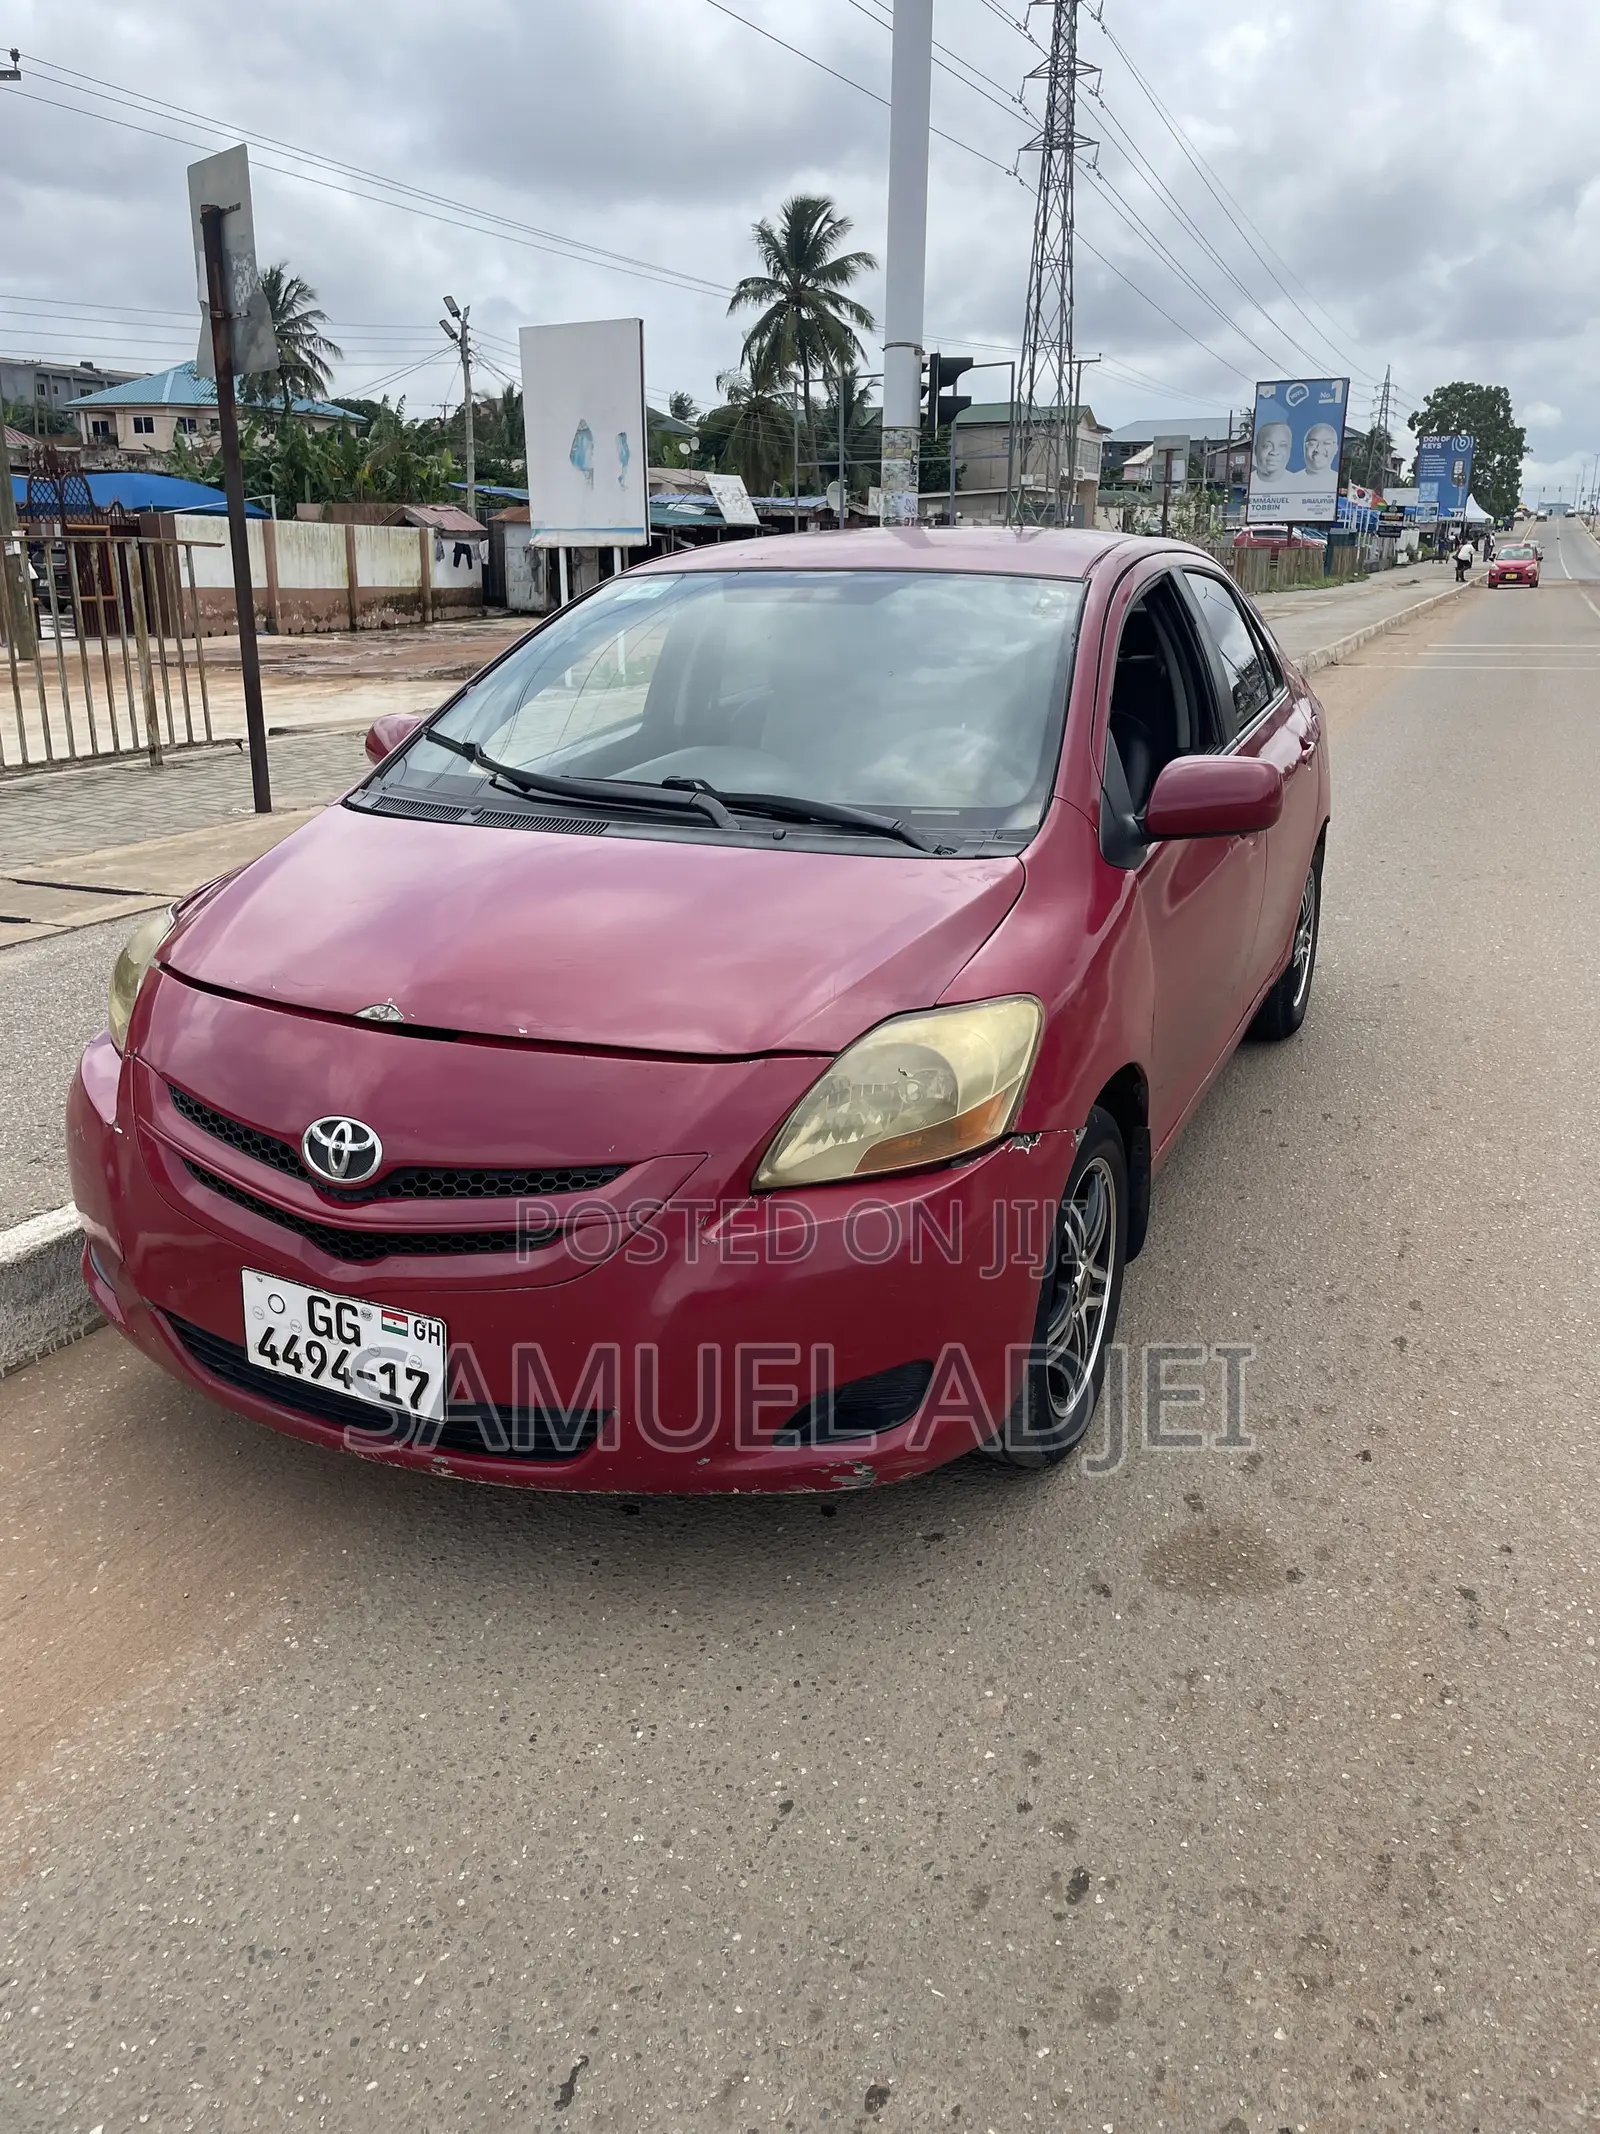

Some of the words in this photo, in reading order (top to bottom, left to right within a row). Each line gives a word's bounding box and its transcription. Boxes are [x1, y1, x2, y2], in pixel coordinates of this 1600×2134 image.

[307, 1295, 361, 1347] GG
[413, 1319, 441, 1346] GH
[258, 1326, 430, 1410] 4494-17
